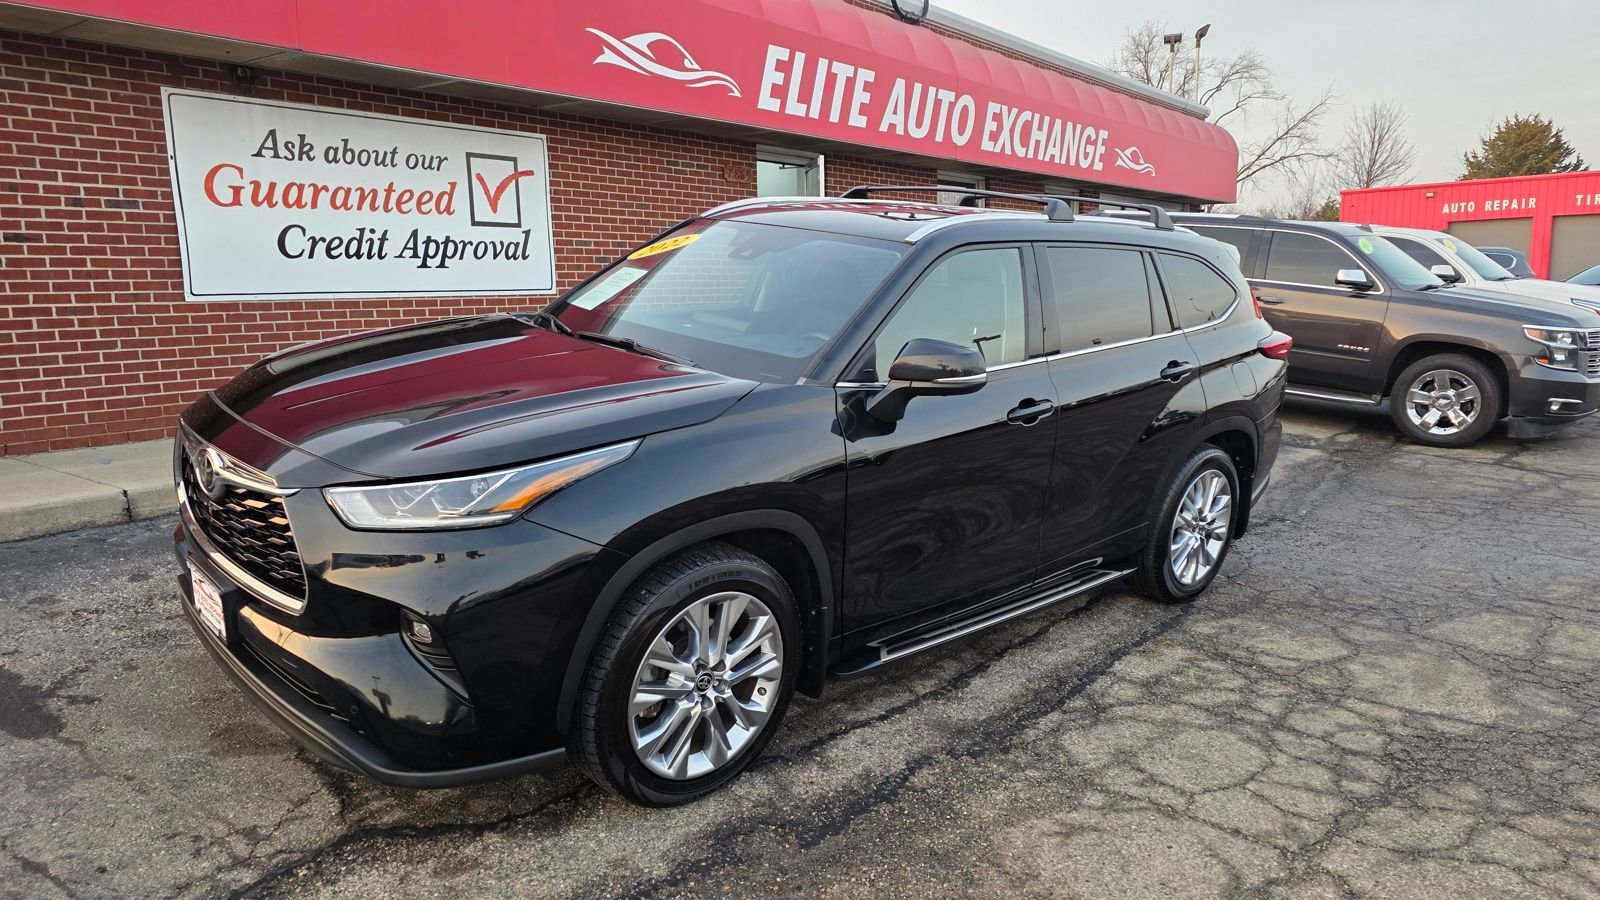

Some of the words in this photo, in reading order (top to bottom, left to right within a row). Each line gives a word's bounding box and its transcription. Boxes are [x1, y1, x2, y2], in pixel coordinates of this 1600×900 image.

[756, 43, 876, 129] ELITE
[878, 77, 977, 148] AUTO
[980, 101, 1109, 172] EXCHANGE
[250, 127, 316, 162] Ask
[323, 138, 399, 169] about
[404, 153, 449, 172] our
[203, 162, 457, 216] Guaranteed
[1442, 203, 1476, 214] AUTO
[1484, 197, 1537, 212] REPAIR
[1575, 193, 1600, 206] TIR
[276, 224, 389, 261] Credit
[393, 228, 532, 269] Approval
